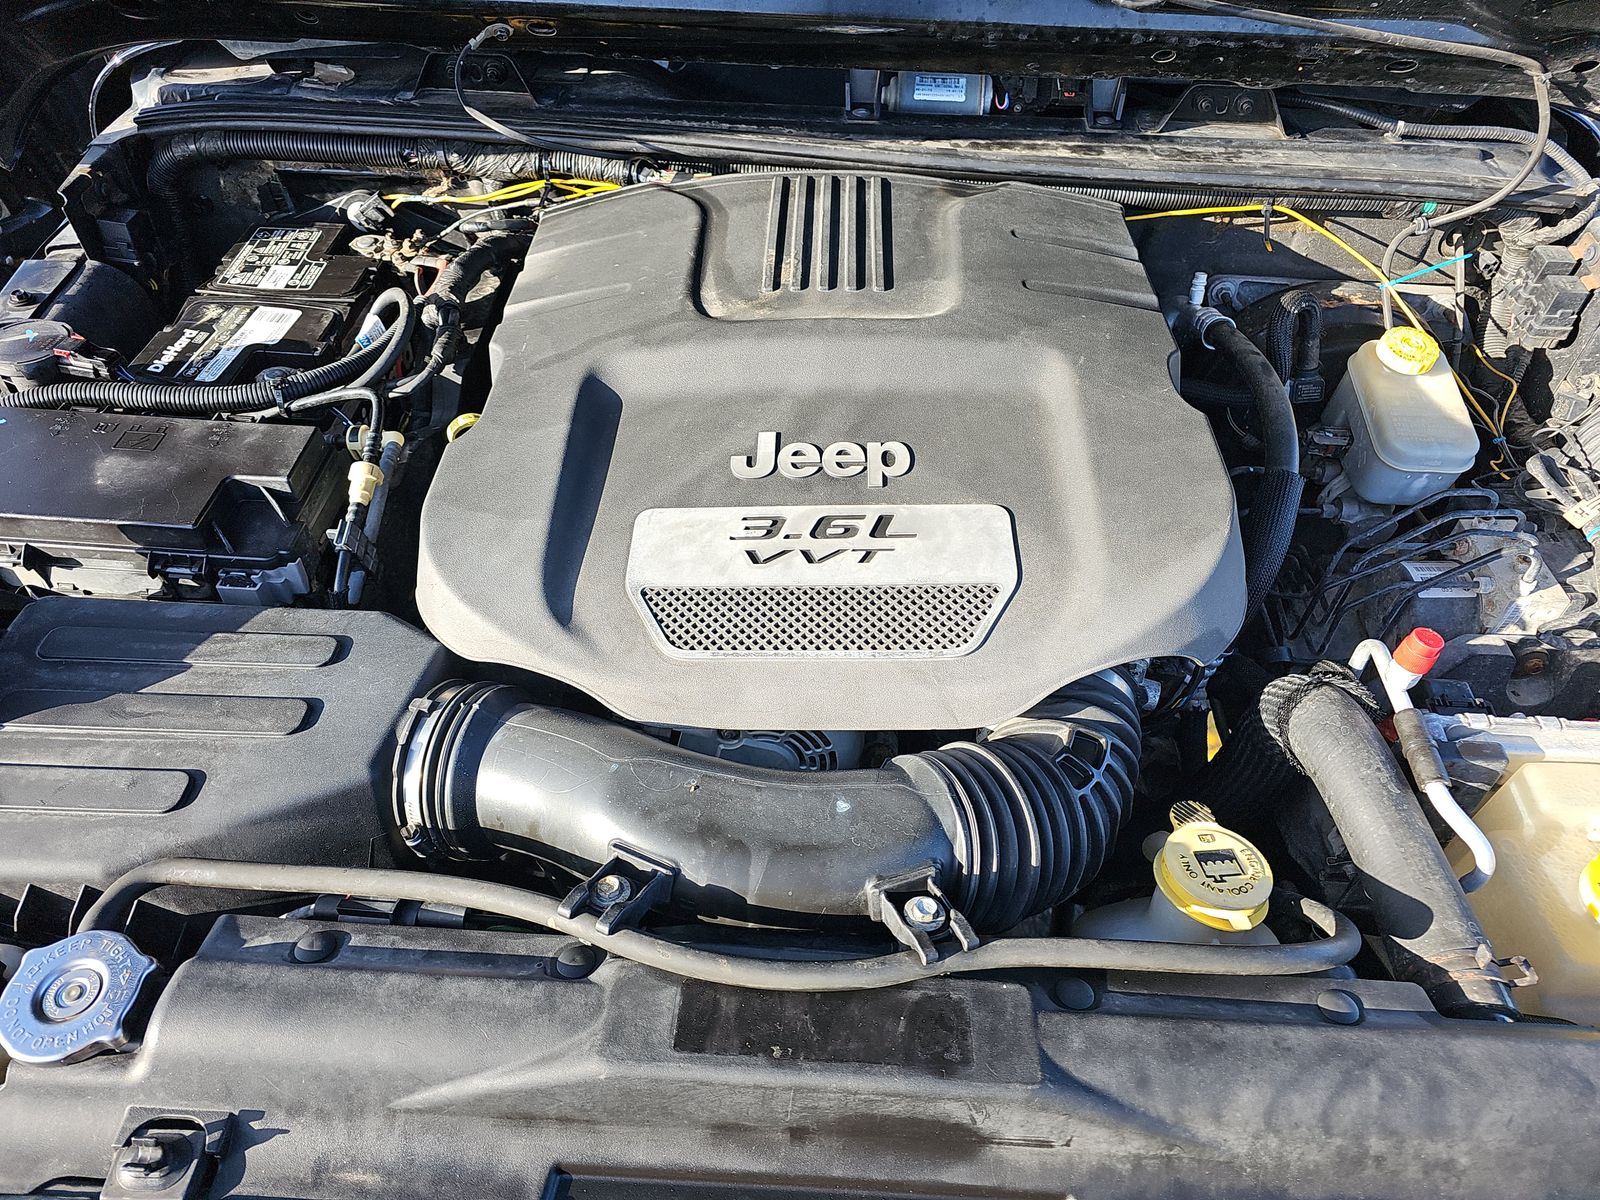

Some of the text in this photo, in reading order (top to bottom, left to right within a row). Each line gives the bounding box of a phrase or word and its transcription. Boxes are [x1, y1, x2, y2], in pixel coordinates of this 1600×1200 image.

[146, 329, 199, 373] DieHard
[730, 431, 914, 488] Jeep
[729, 514, 917, 540] 3.6L
[744, 549, 895, 564] VVT
[1179, 848, 1265, 896] ENGINE COOLANT ONLY
[42, 938, 133, 970] KEEP TIGHT
[5, 1018, 34, 1045] NOT
[31, 1029, 79, 1050] OPEN
[82, 1001, 115, 1035] HOT
